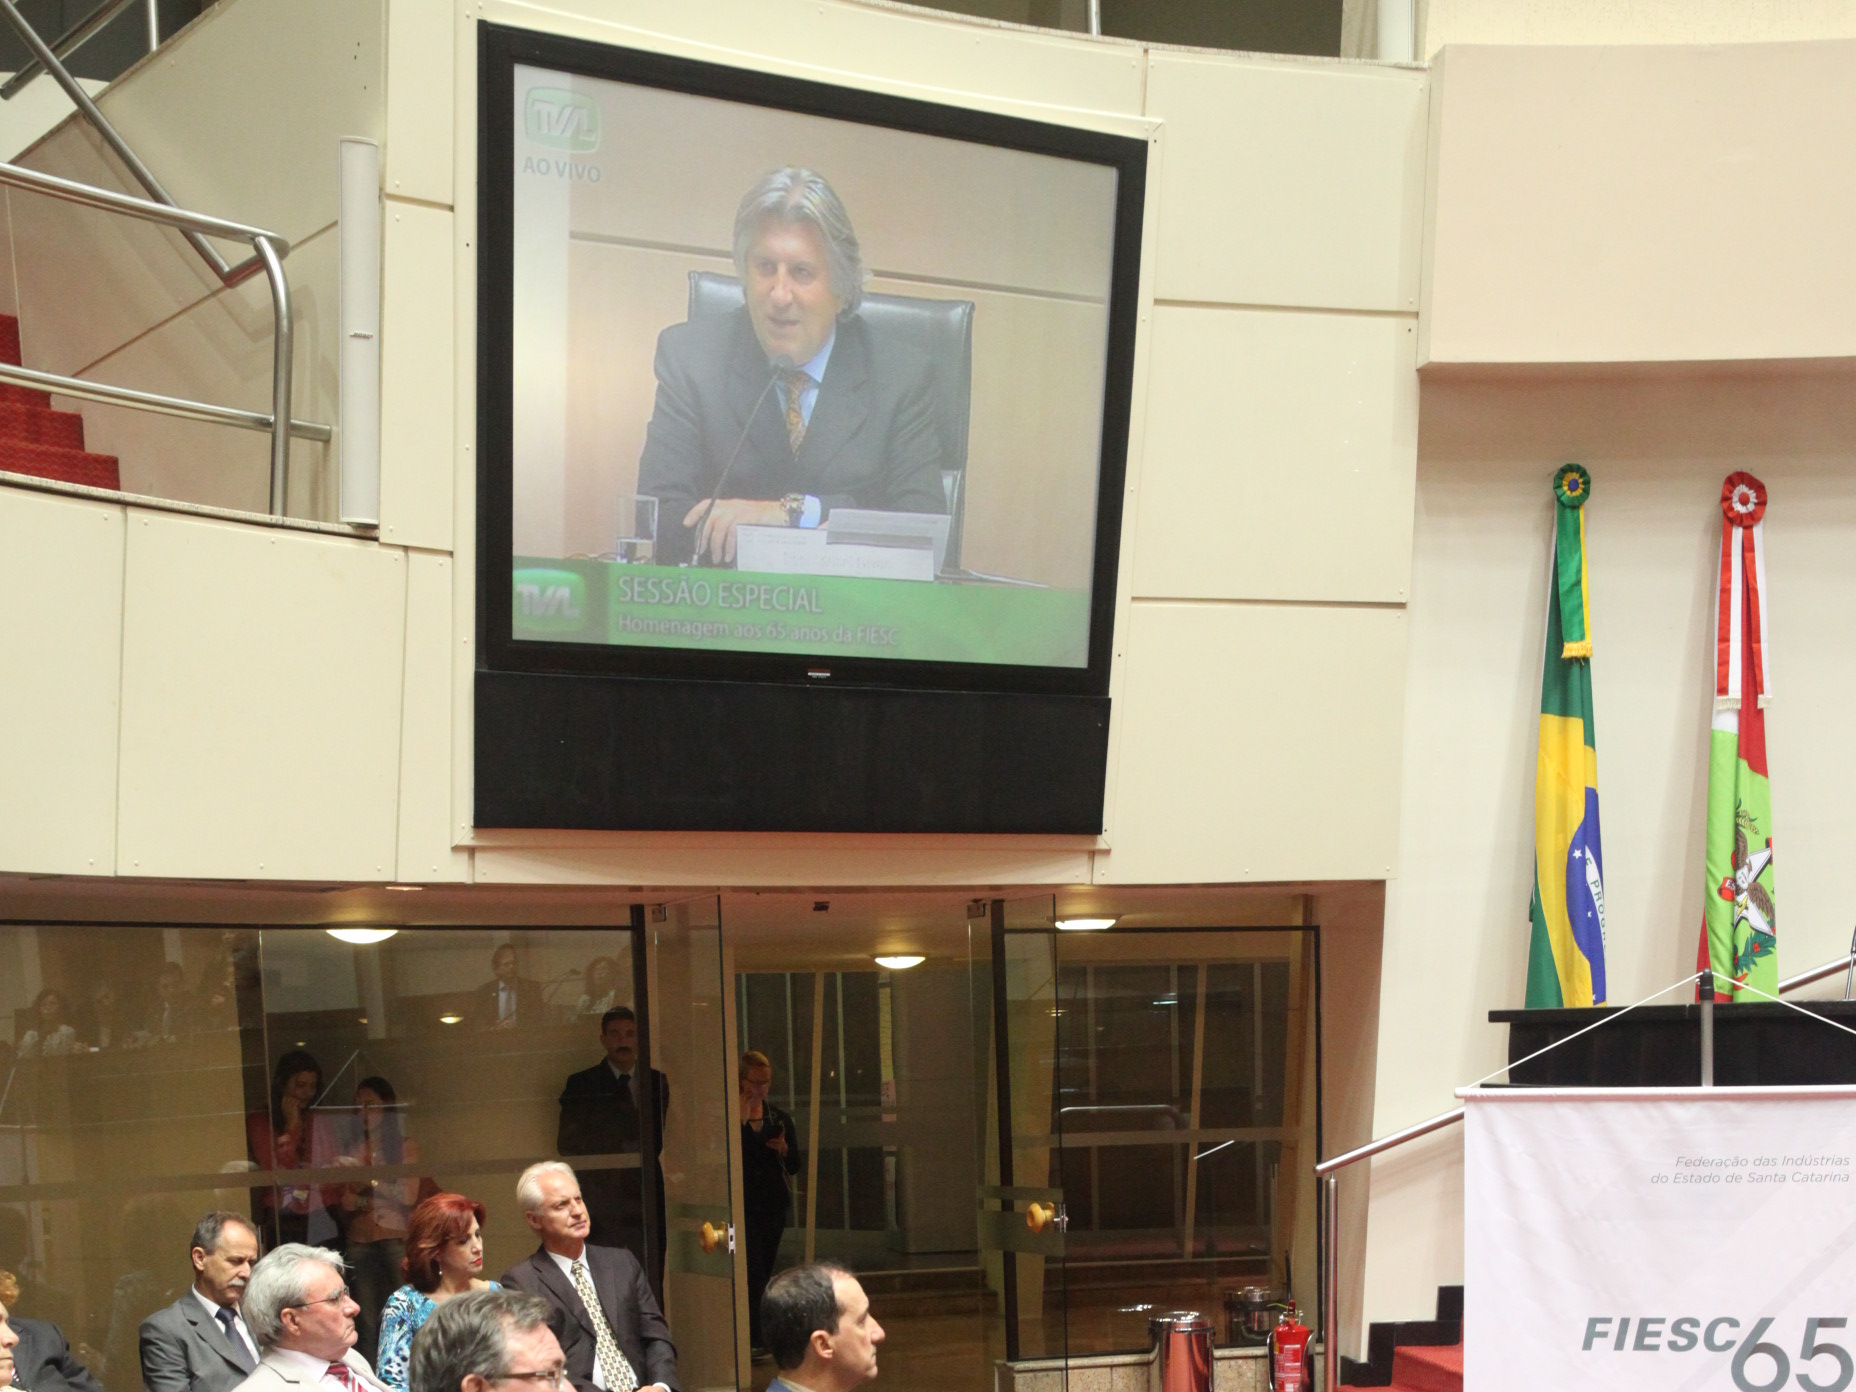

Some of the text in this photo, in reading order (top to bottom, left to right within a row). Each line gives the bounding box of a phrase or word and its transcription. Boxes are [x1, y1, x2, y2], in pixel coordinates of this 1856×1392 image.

[523, 157, 602, 183] AO VIVO
[618, 574, 824, 613] SESSÃO ESPECIAL
[618, 613, 900, 645] Homenagem aos 65 anos da FIESC
[1675, 1154, 1851, 1169] Federação das Indústrias
[1650, 1171, 1850, 1184] do Estado de Santa Catarina
[1581, 1316, 1741, 1353] FIESC
